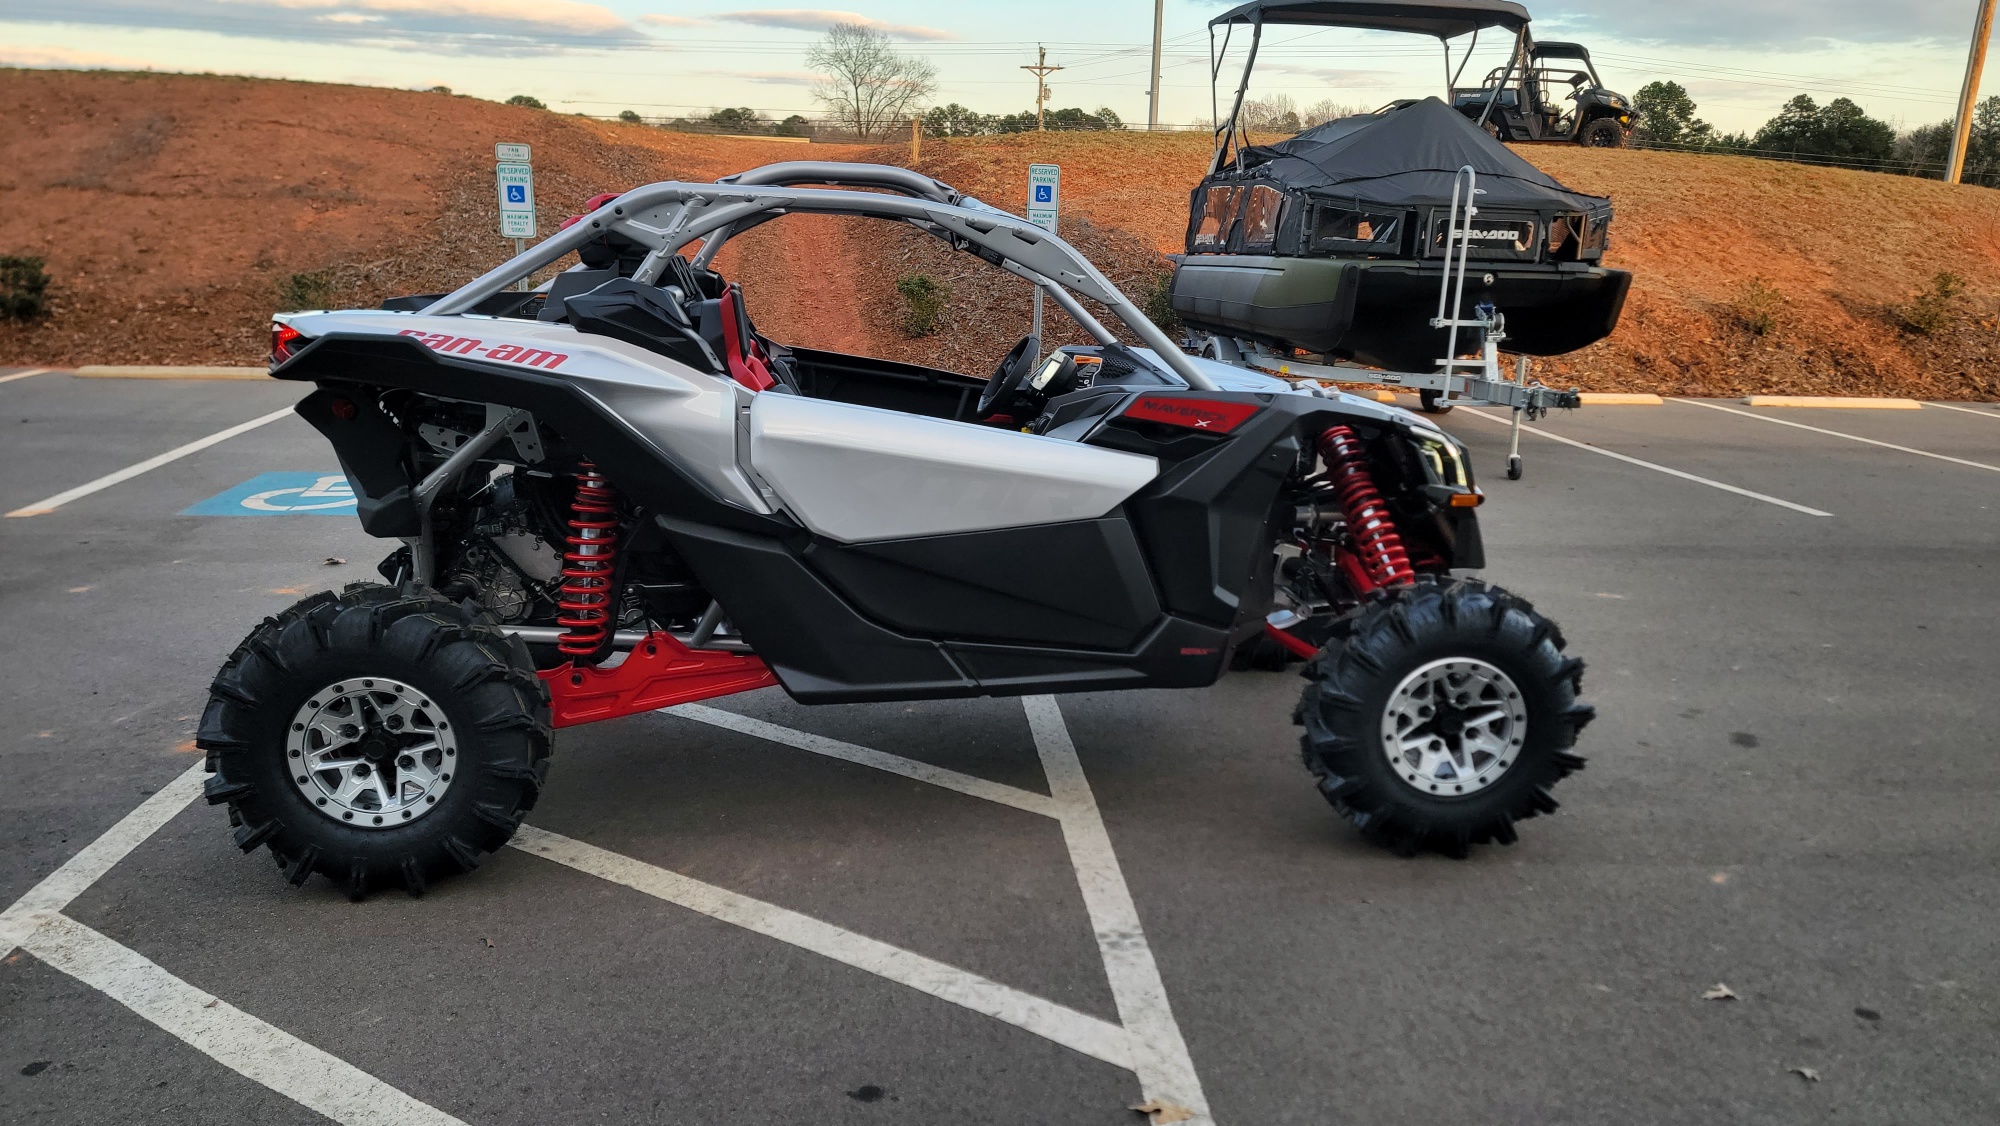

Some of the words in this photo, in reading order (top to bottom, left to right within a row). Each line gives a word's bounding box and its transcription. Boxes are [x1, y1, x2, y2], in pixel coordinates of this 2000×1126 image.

[500, 167, 529, 175] RESERVED
[1031, 168, 1058, 176] RESERVED
[502, 176, 528, 184] PARKING
[1033, 176, 1056, 184] PARKING
[1143, 401, 1227, 422] MAVERICK
